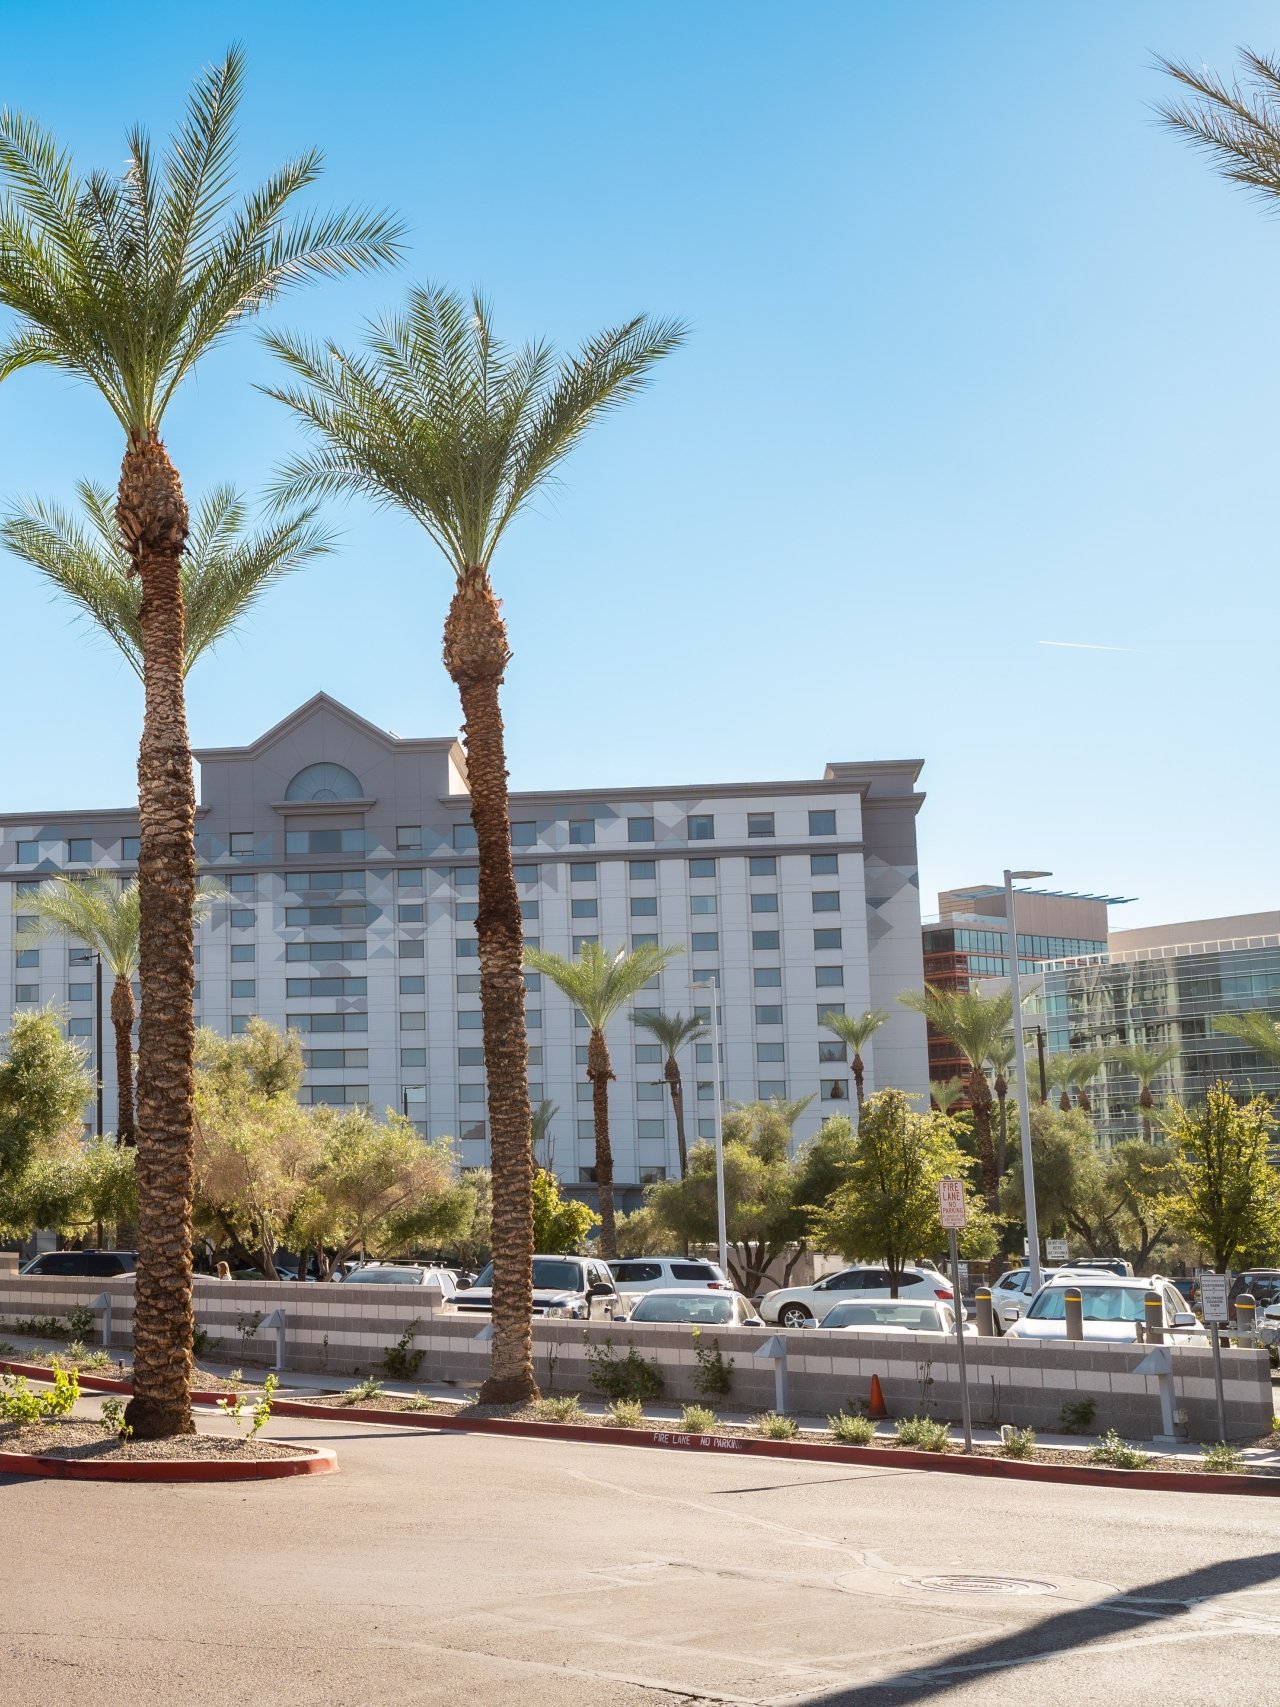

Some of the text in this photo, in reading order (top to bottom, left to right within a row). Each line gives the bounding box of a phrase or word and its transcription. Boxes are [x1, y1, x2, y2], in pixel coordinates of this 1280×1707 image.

[943, 1183, 958, 1191] FIRE
[943, 1192, 960, 1200] LANE
[653, 1432, 669, 1444] FIRE
[672, 1434, 691, 1446] LANE
[701, 1437, 710, 1446] NO
